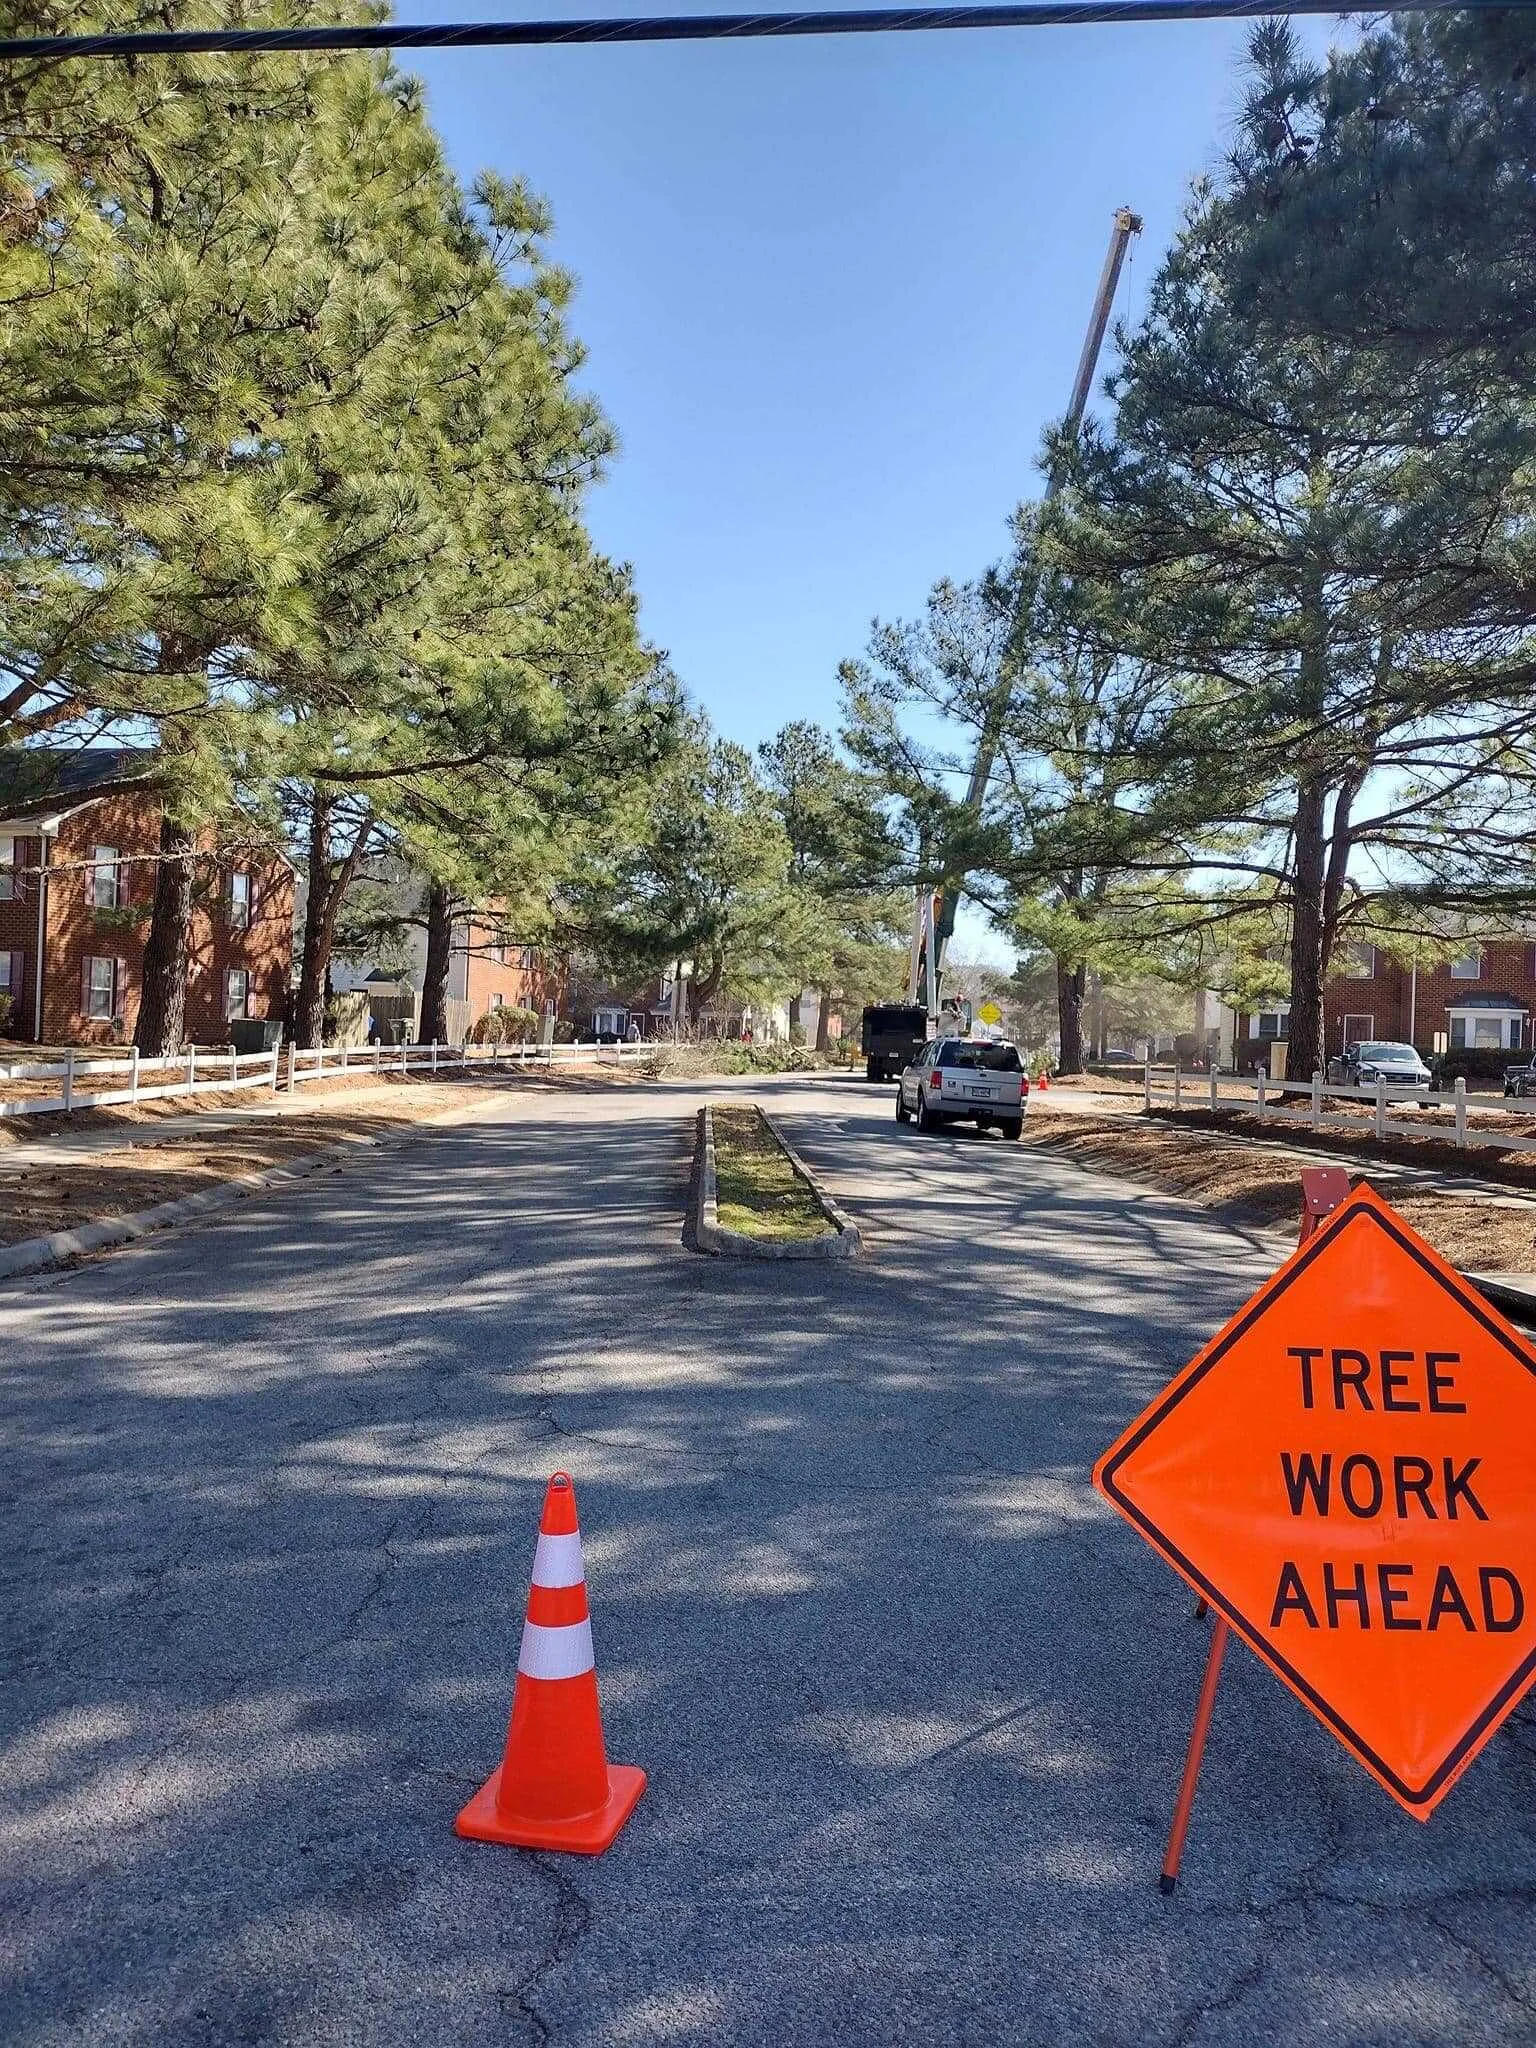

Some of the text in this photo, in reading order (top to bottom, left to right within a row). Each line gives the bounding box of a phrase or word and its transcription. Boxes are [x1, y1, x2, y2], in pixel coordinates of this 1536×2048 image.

[1287, 1347, 1467, 1414] TREE
[1280, 1452, 1490, 1521] WORK
[1269, 1561, 1525, 1633] AHEAD
